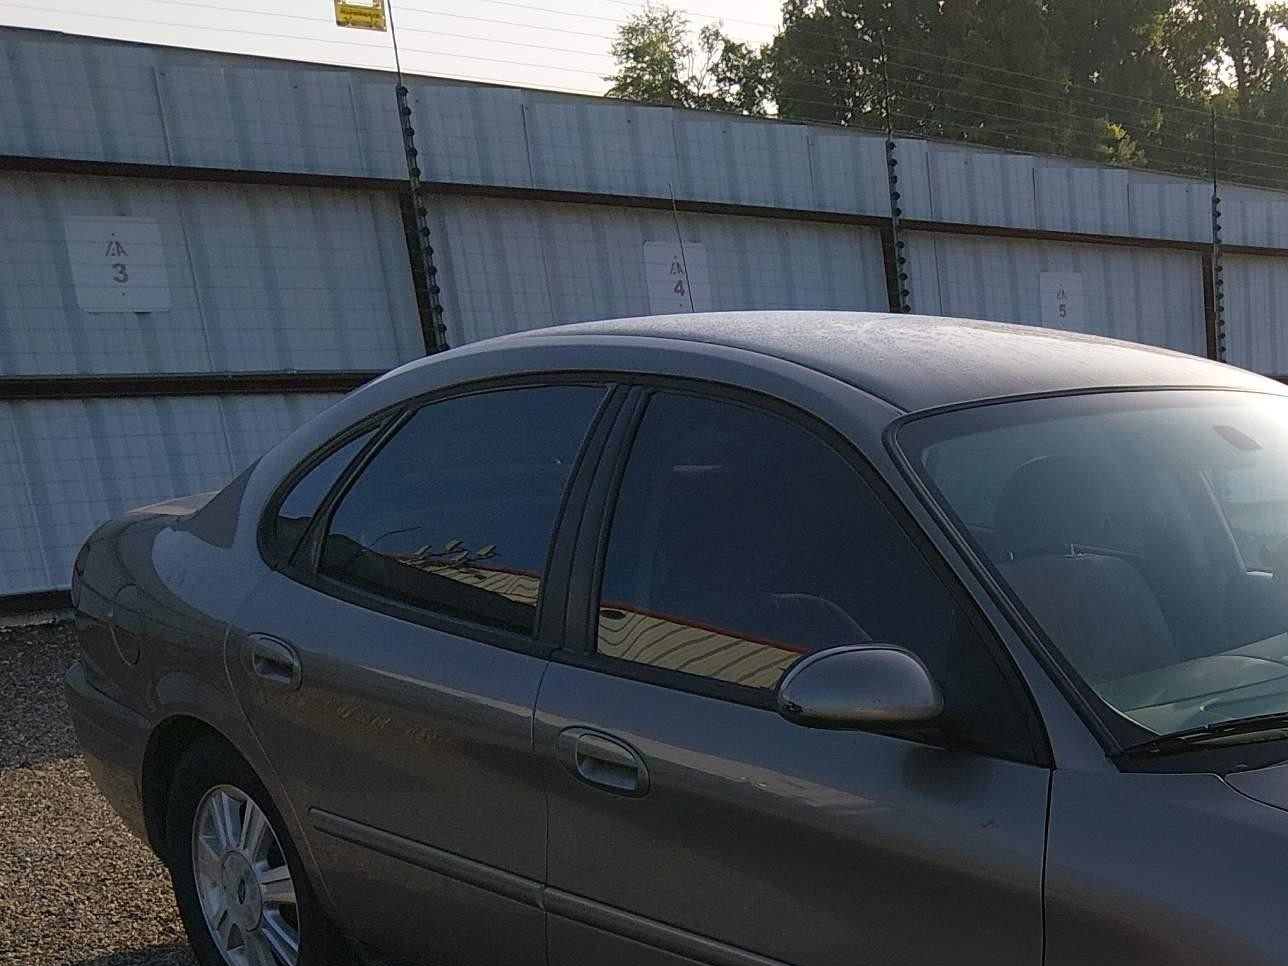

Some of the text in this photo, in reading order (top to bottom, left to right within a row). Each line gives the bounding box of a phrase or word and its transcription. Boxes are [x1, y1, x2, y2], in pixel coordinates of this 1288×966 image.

[111, 262, 129, 283] 3
[674, 279, 686, 296] 4
[1058, 303, 1067, 318] 5
